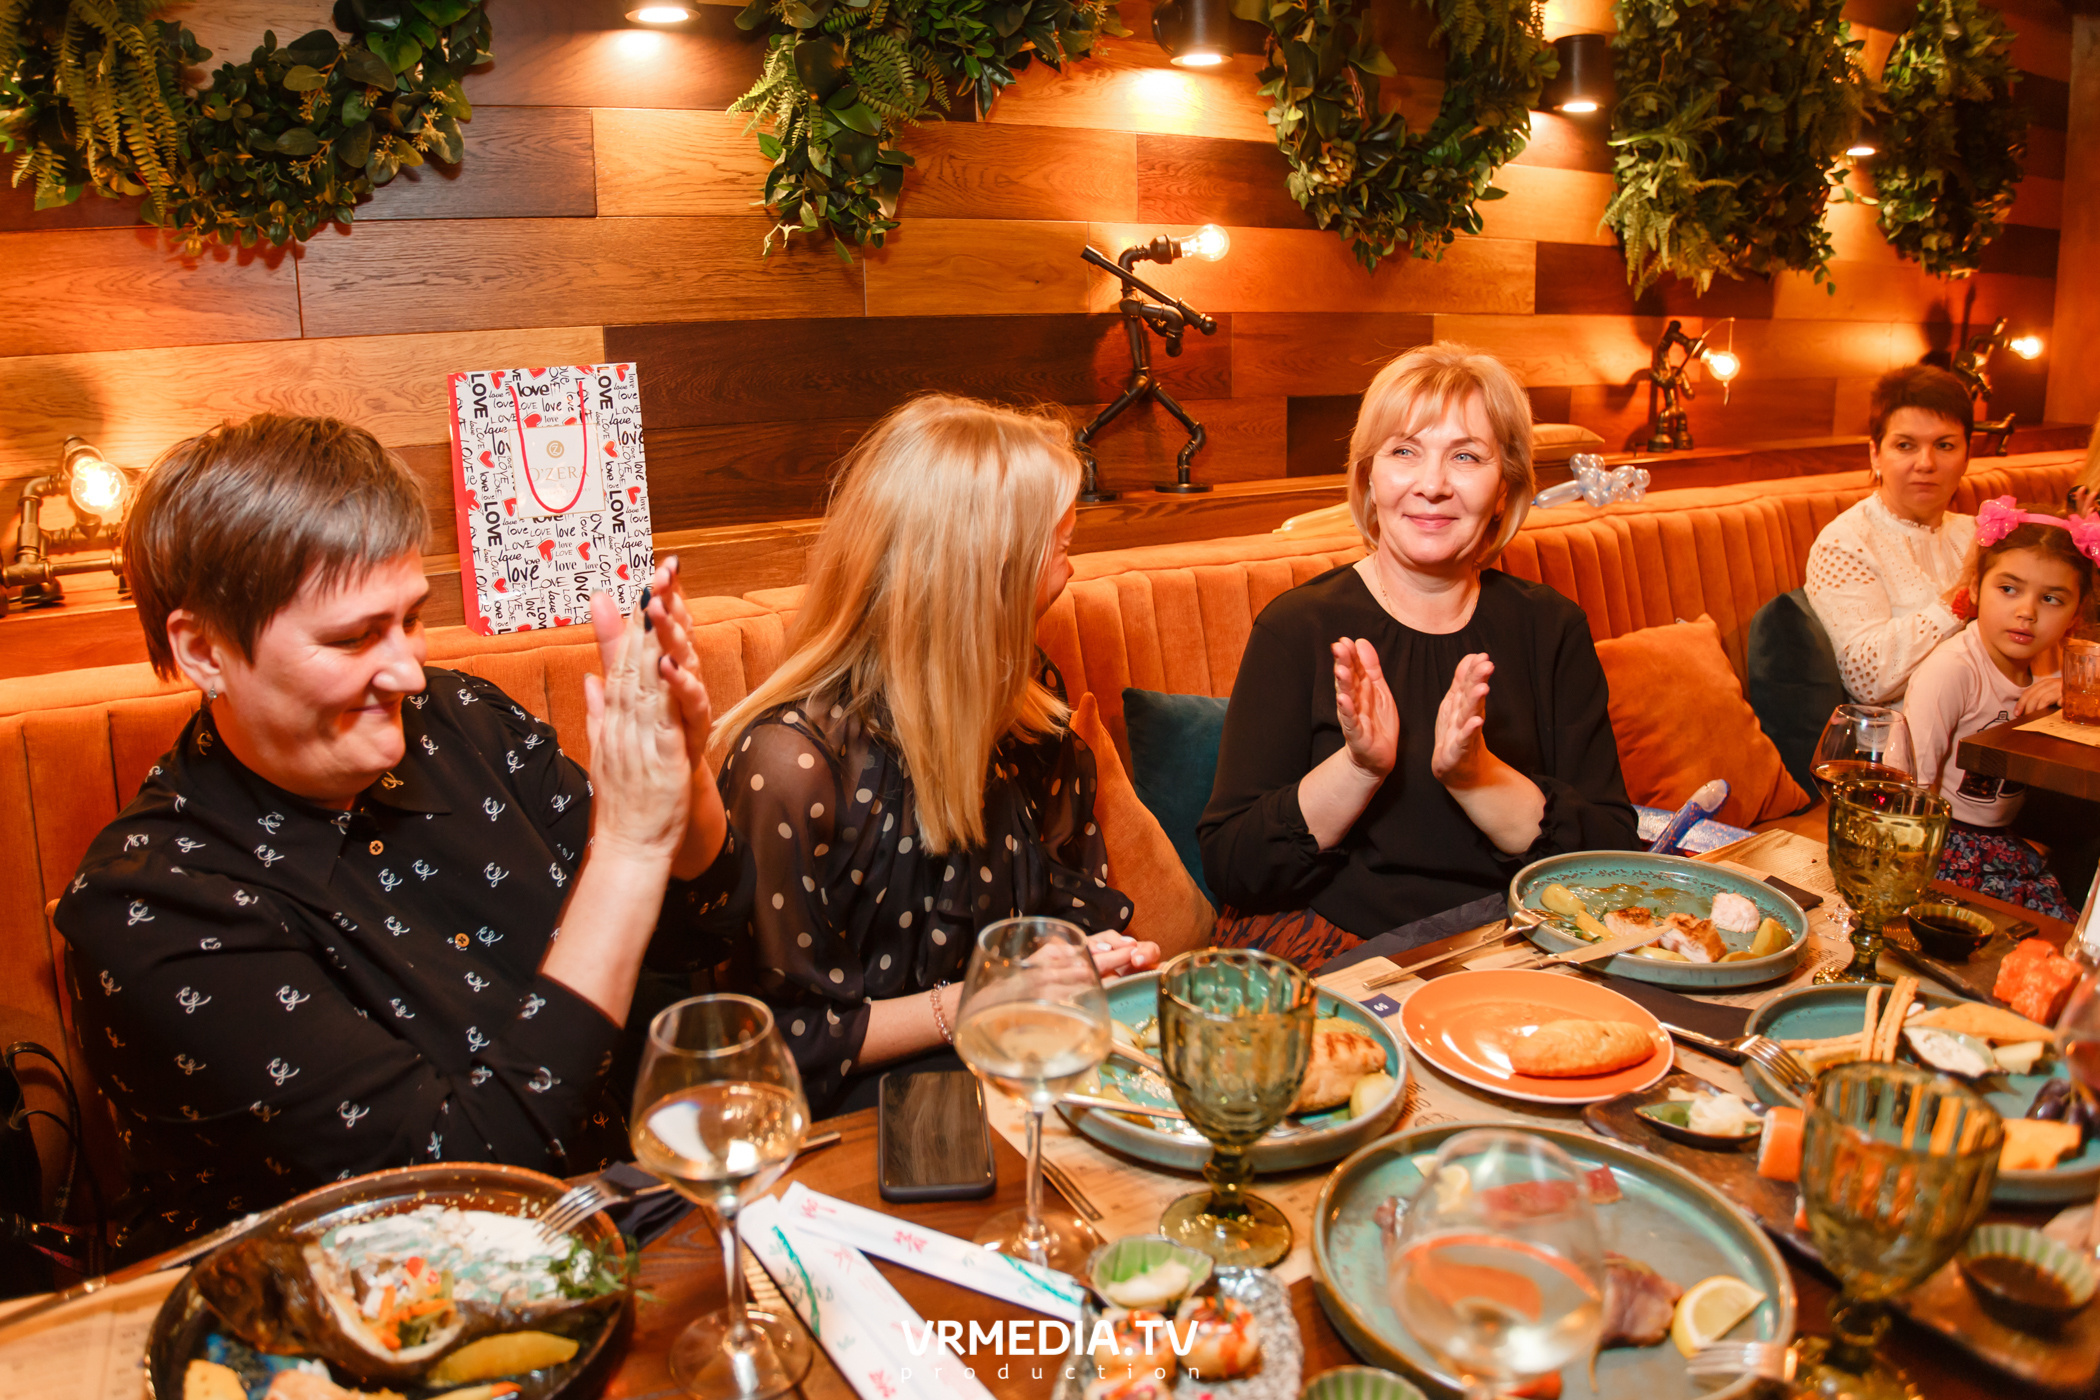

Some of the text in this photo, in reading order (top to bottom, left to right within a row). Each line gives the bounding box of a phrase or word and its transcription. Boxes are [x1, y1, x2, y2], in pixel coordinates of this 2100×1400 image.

[517, 382, 550, 397] love
[597, 366, 613, 410] LOVE
[618, 390, 638, 400] love
[471, 374, 488, 419] LOVE
[494, 399, 516, 408] love
[541, 397, 562, 412] love
[544, 415, 559, 423] love
[609, 490, 625, 535] LOVE
[630, 514, 649, 524] love
[484, 501, 502, 546] LOVE
[508, 526, 529, 536] love
[555, 523, 576, 538] love
[530, 528, 551, 538] LOVE
[504, 540, 535, 552] LOVE
[558, 541, 572, 549] love
[555, 560, 577, 572] love
[585, 563, 598, 573] love
[599, 554, 611, 588] LOVE
[531, 577, 570, 591] LOVE
[574, 570, 596, 602] love
[525, 597, 537, 618] love
[563, 589, 573, 615] LOVE
[537, 606, 548, 630] LOV
